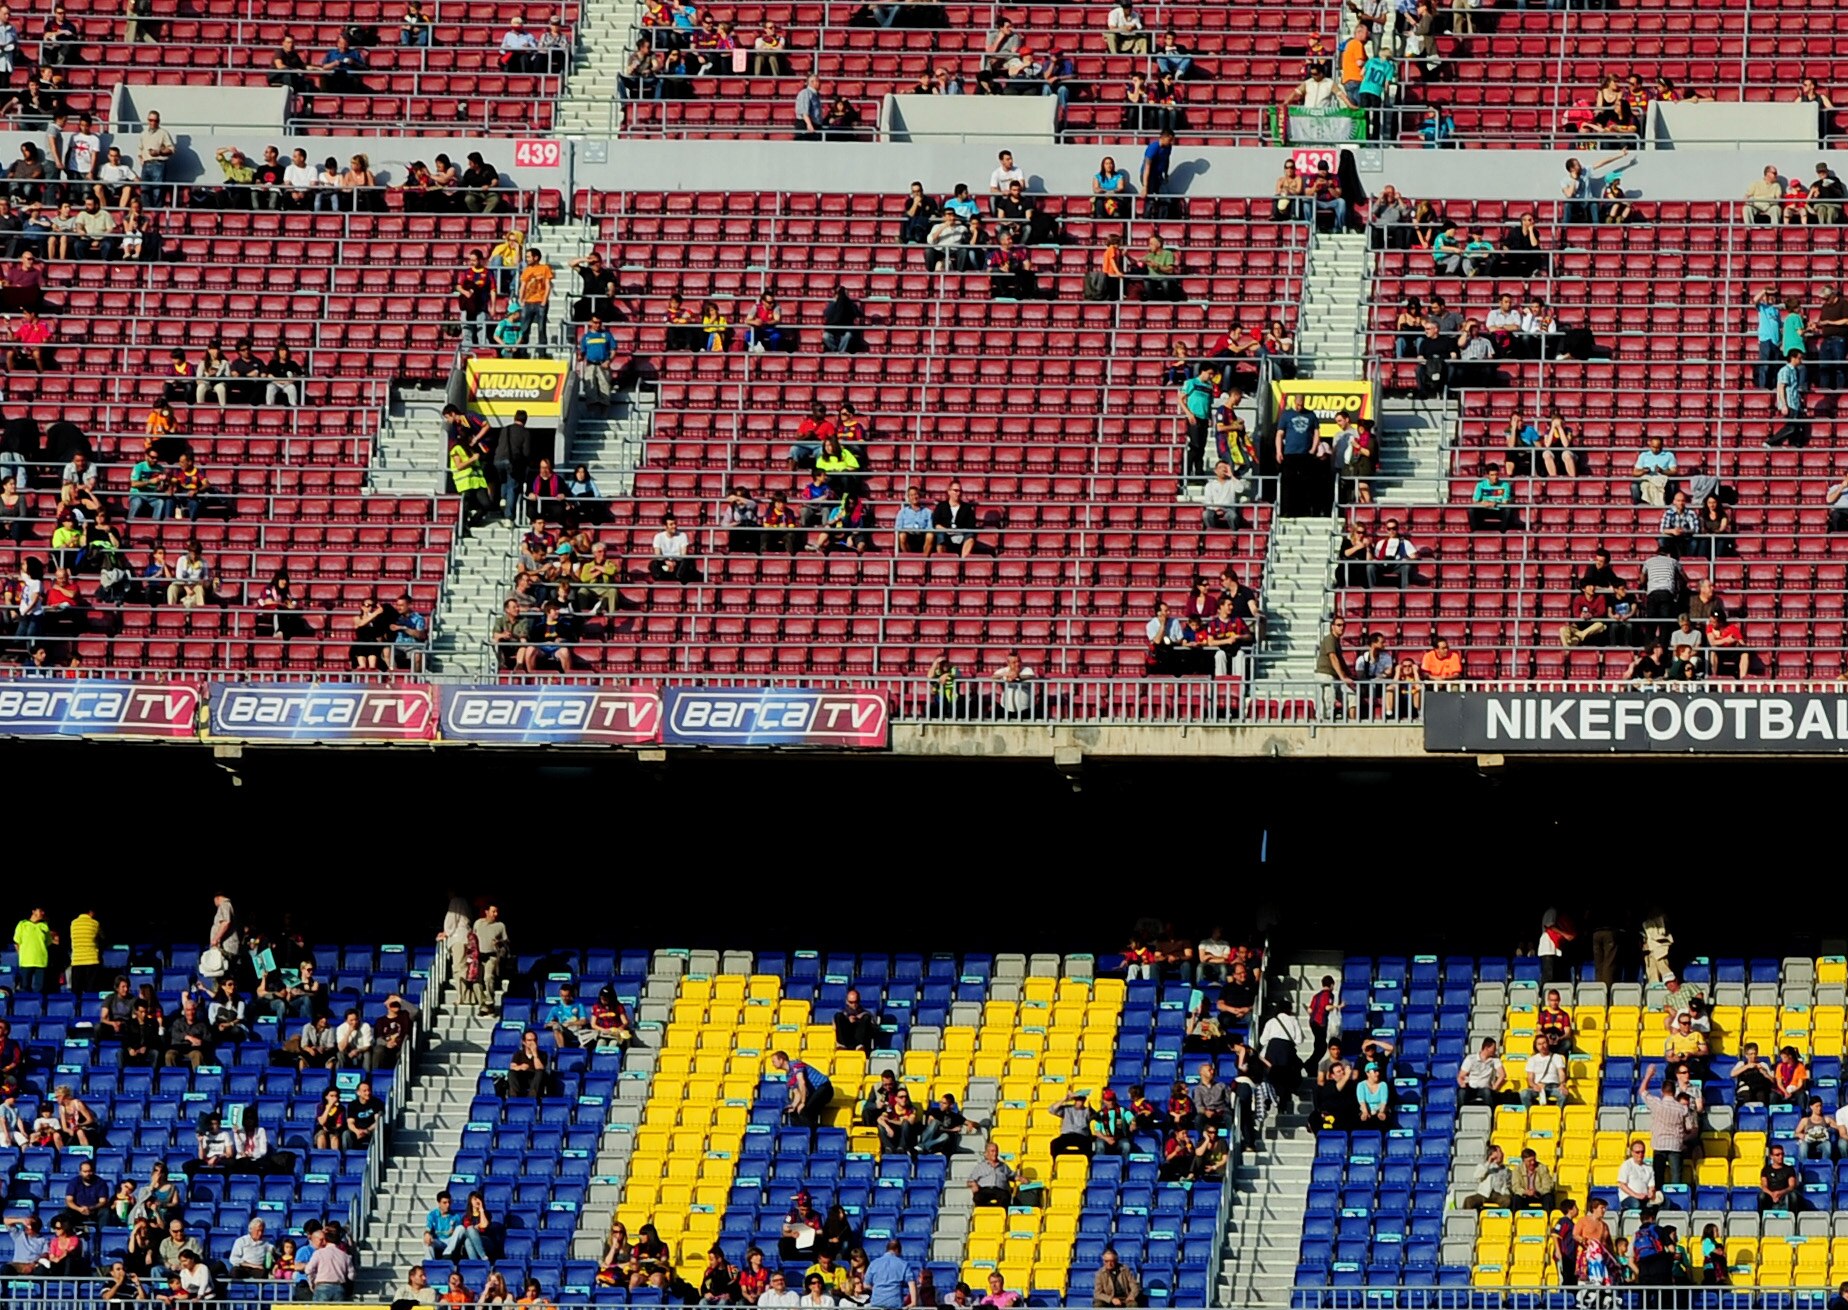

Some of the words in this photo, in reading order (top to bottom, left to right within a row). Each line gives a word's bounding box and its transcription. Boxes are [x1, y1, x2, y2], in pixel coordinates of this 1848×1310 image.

[517, 143, 558, 165] 439
[478, 373, 558, 391] MUNDO
[135, 693, 191, 720] TV
[367, 698, 422, 725] TV
[600, 701, 654, 728] TV
[822, 703, 877, 729] TV
